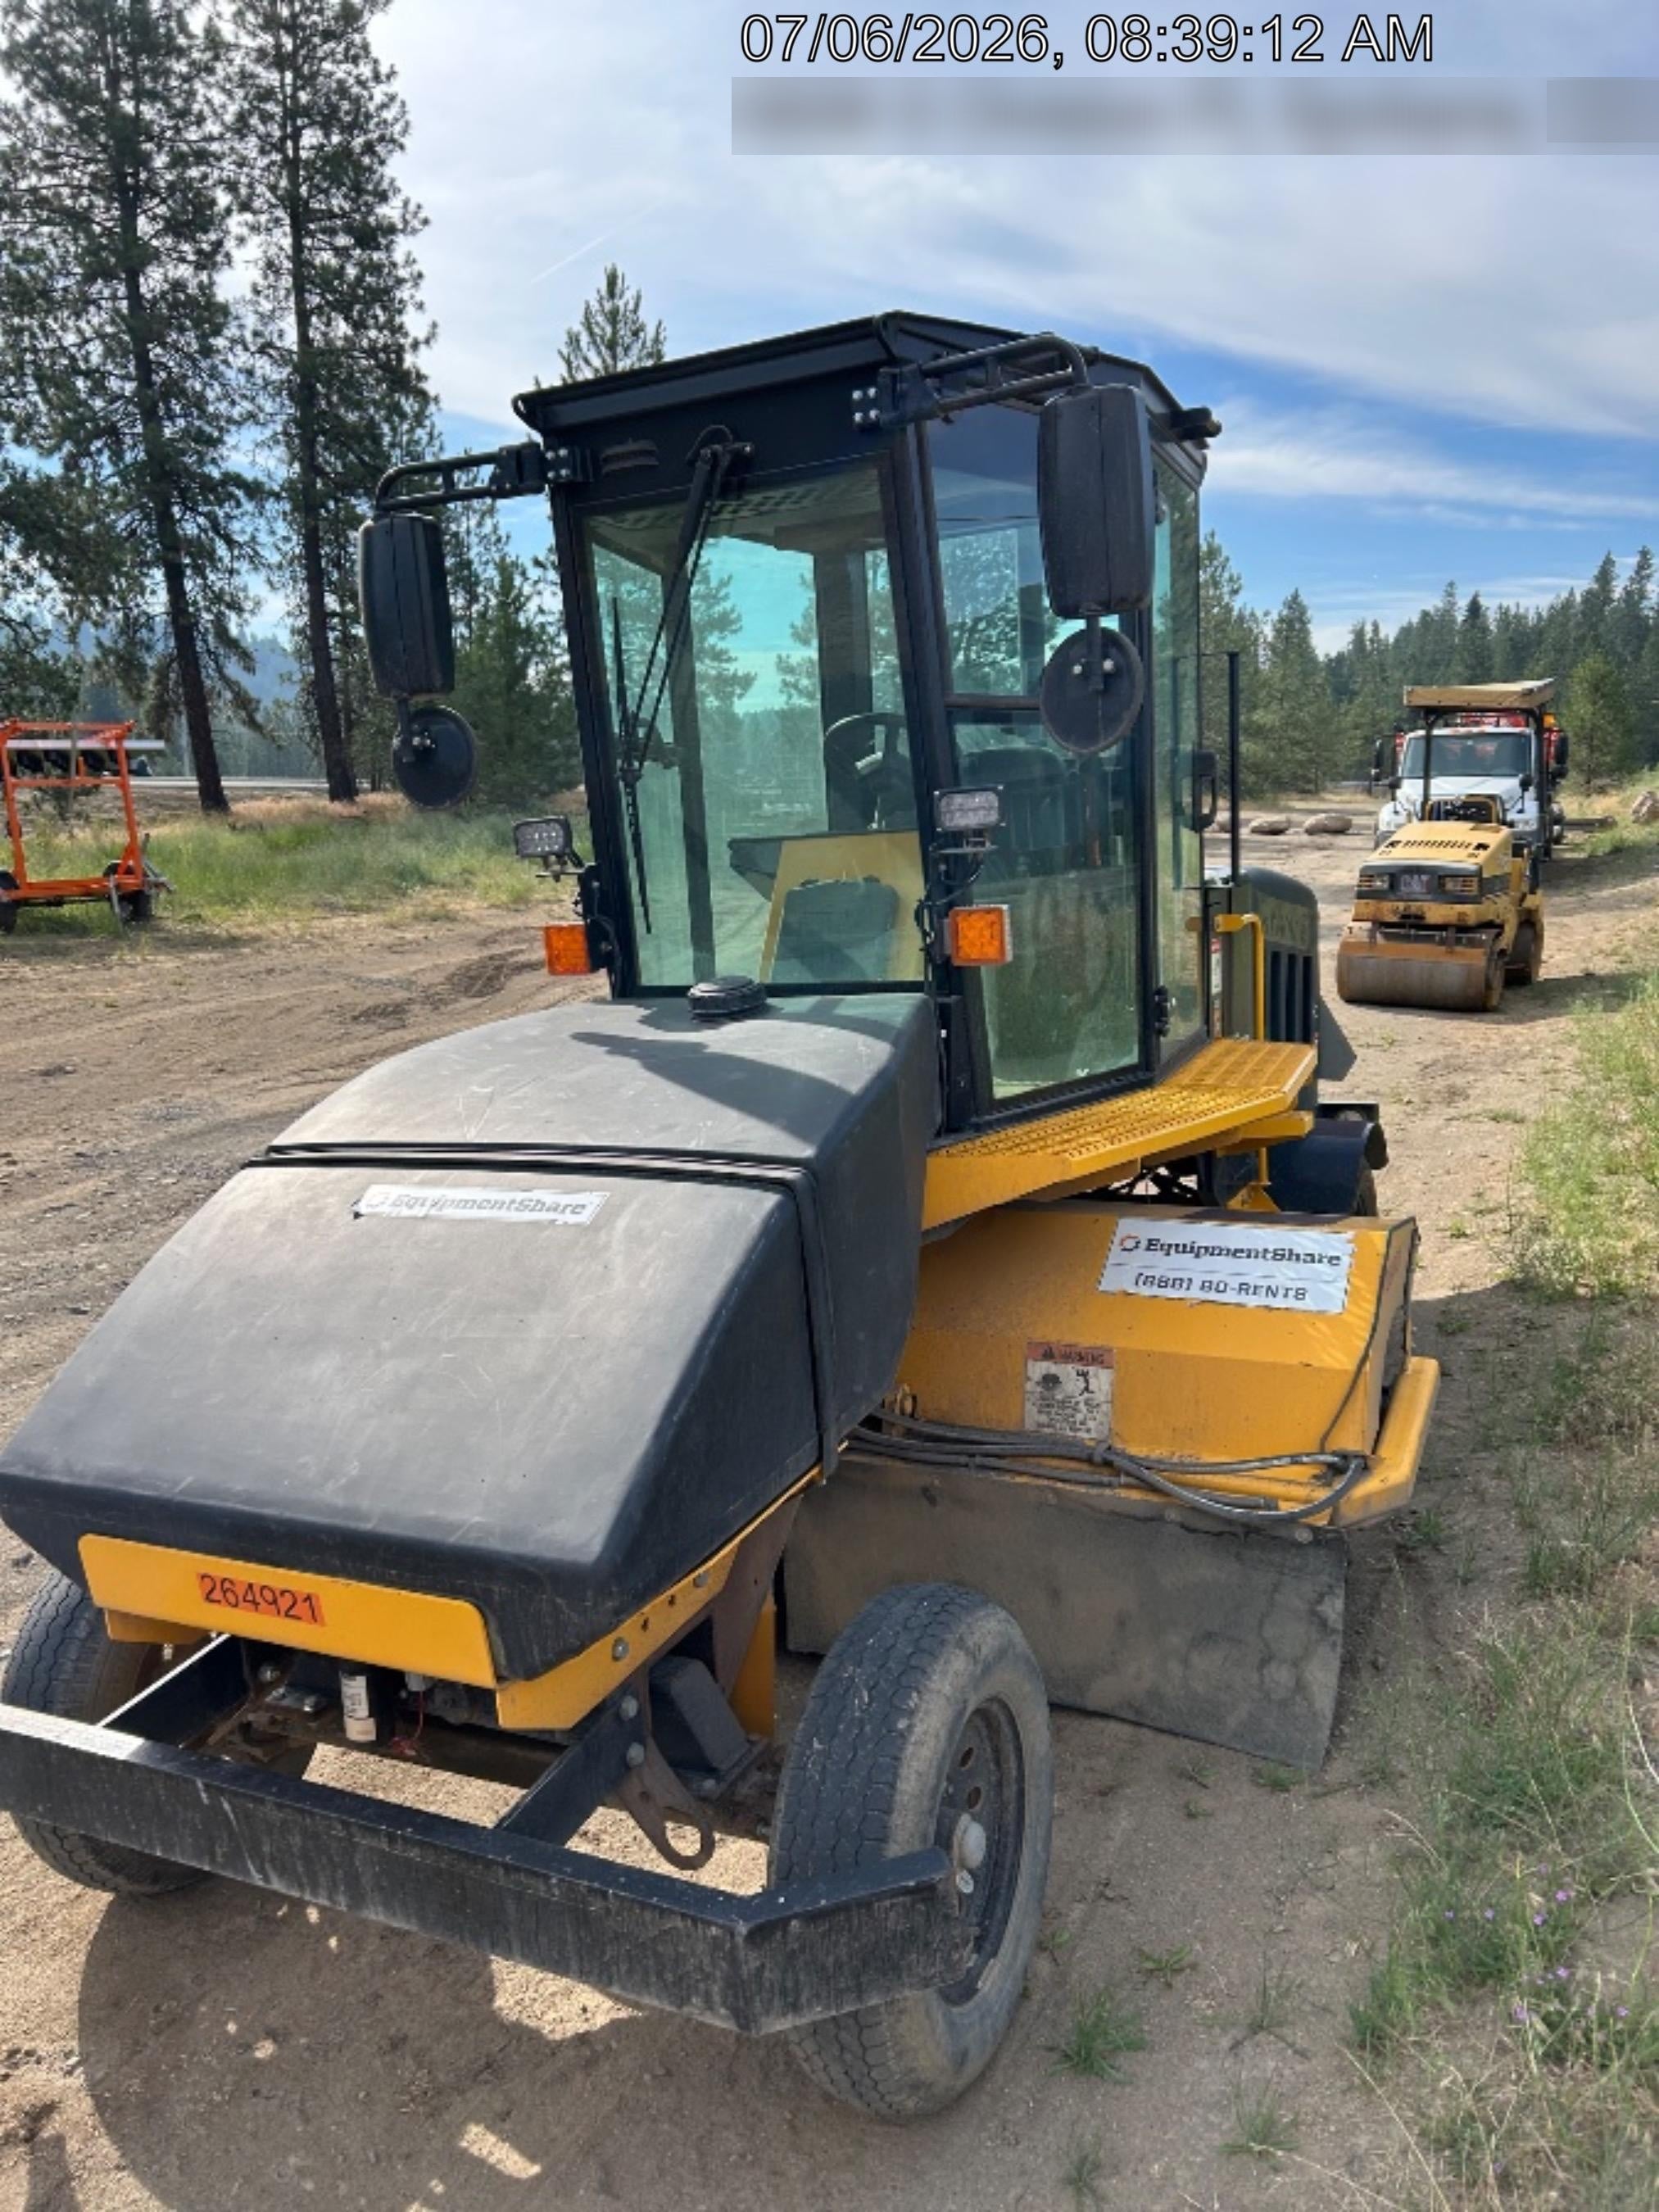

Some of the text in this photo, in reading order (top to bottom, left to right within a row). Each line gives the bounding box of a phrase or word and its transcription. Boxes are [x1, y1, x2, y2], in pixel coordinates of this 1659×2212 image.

[388, 1193, 587, 1215] EquipmentShare
[1145, 1237, 1341, 1267] EquipmentShare
[201, 1573, 318, 1623] 264921
